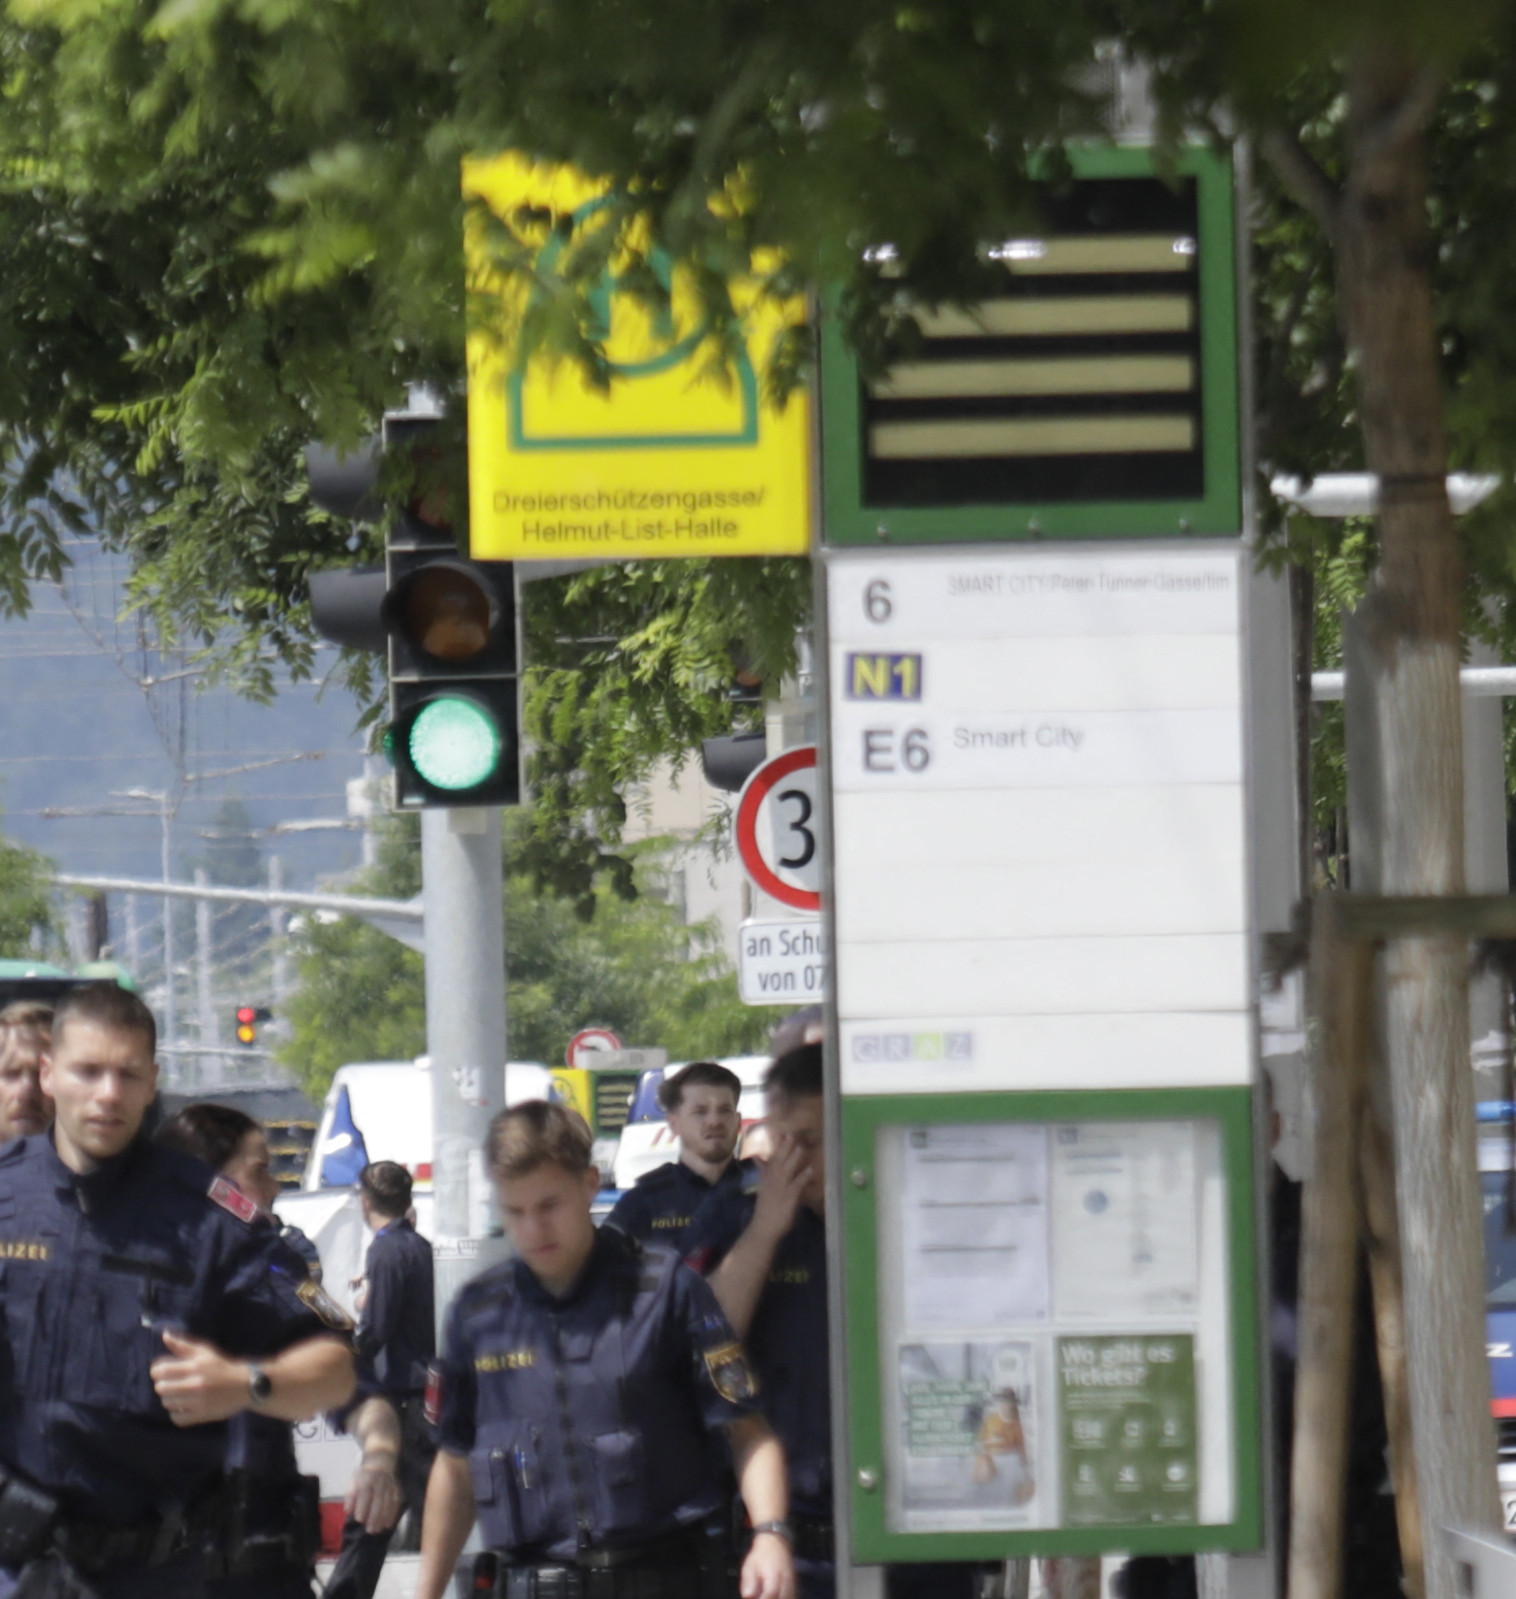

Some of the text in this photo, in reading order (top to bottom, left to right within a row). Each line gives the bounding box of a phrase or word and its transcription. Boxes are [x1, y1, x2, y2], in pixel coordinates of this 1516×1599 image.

[493, 485, 766, 515] Dreierschützengasse/
[522, 516, 739, 543] Helmut-List-Halle
[863, 579, 893, 624] 6
[853, 655, 917, 698] N1
[863, 726, 1084, 773] E6 Smart City
[777, 789, 815, 869] 3
[746, 937, 771, 957] an
[758, 970, 796, 992] von
[853, 1033, 971, 1062] GRAZ
[651, 1216, 691, 1230] POLIZE
[475, 1351, 533, 1373] POLIZEI
[1062, 1343, 1095, 1366] Wo
